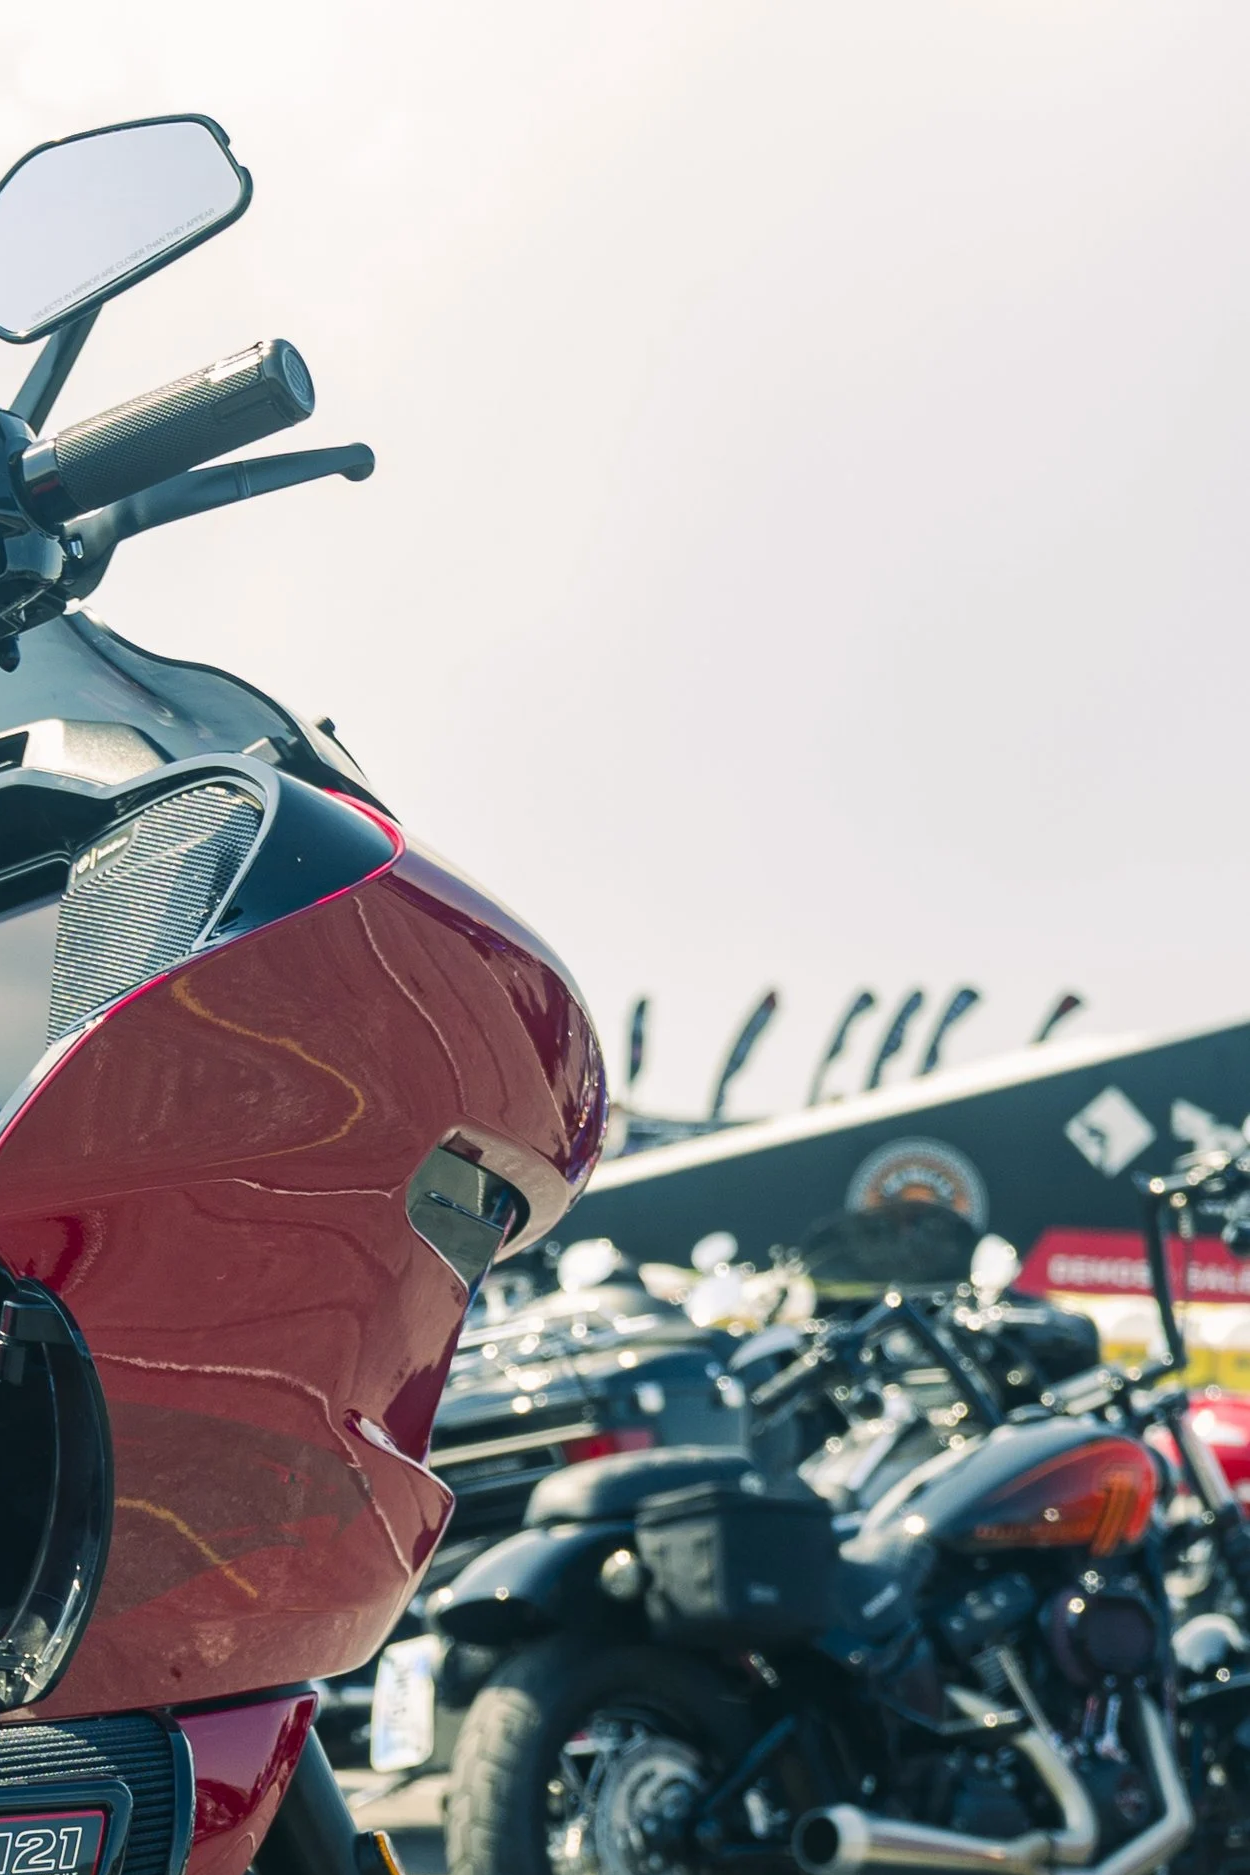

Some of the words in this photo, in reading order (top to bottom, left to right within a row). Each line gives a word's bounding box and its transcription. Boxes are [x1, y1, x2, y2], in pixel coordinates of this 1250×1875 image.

[31, 297, 63, 321] OBJECTS
[63, 291, 73, 302] IN
[72, 273, 101, 296] MIRROR
[100, 264, 116, 278] ARE
[115, 247, 145, 270] CLOSER
[144, 234, 166, 252] THAN
[165, 223, 185, 239] THEY
[186, 207, 216, 229] APPEAR
